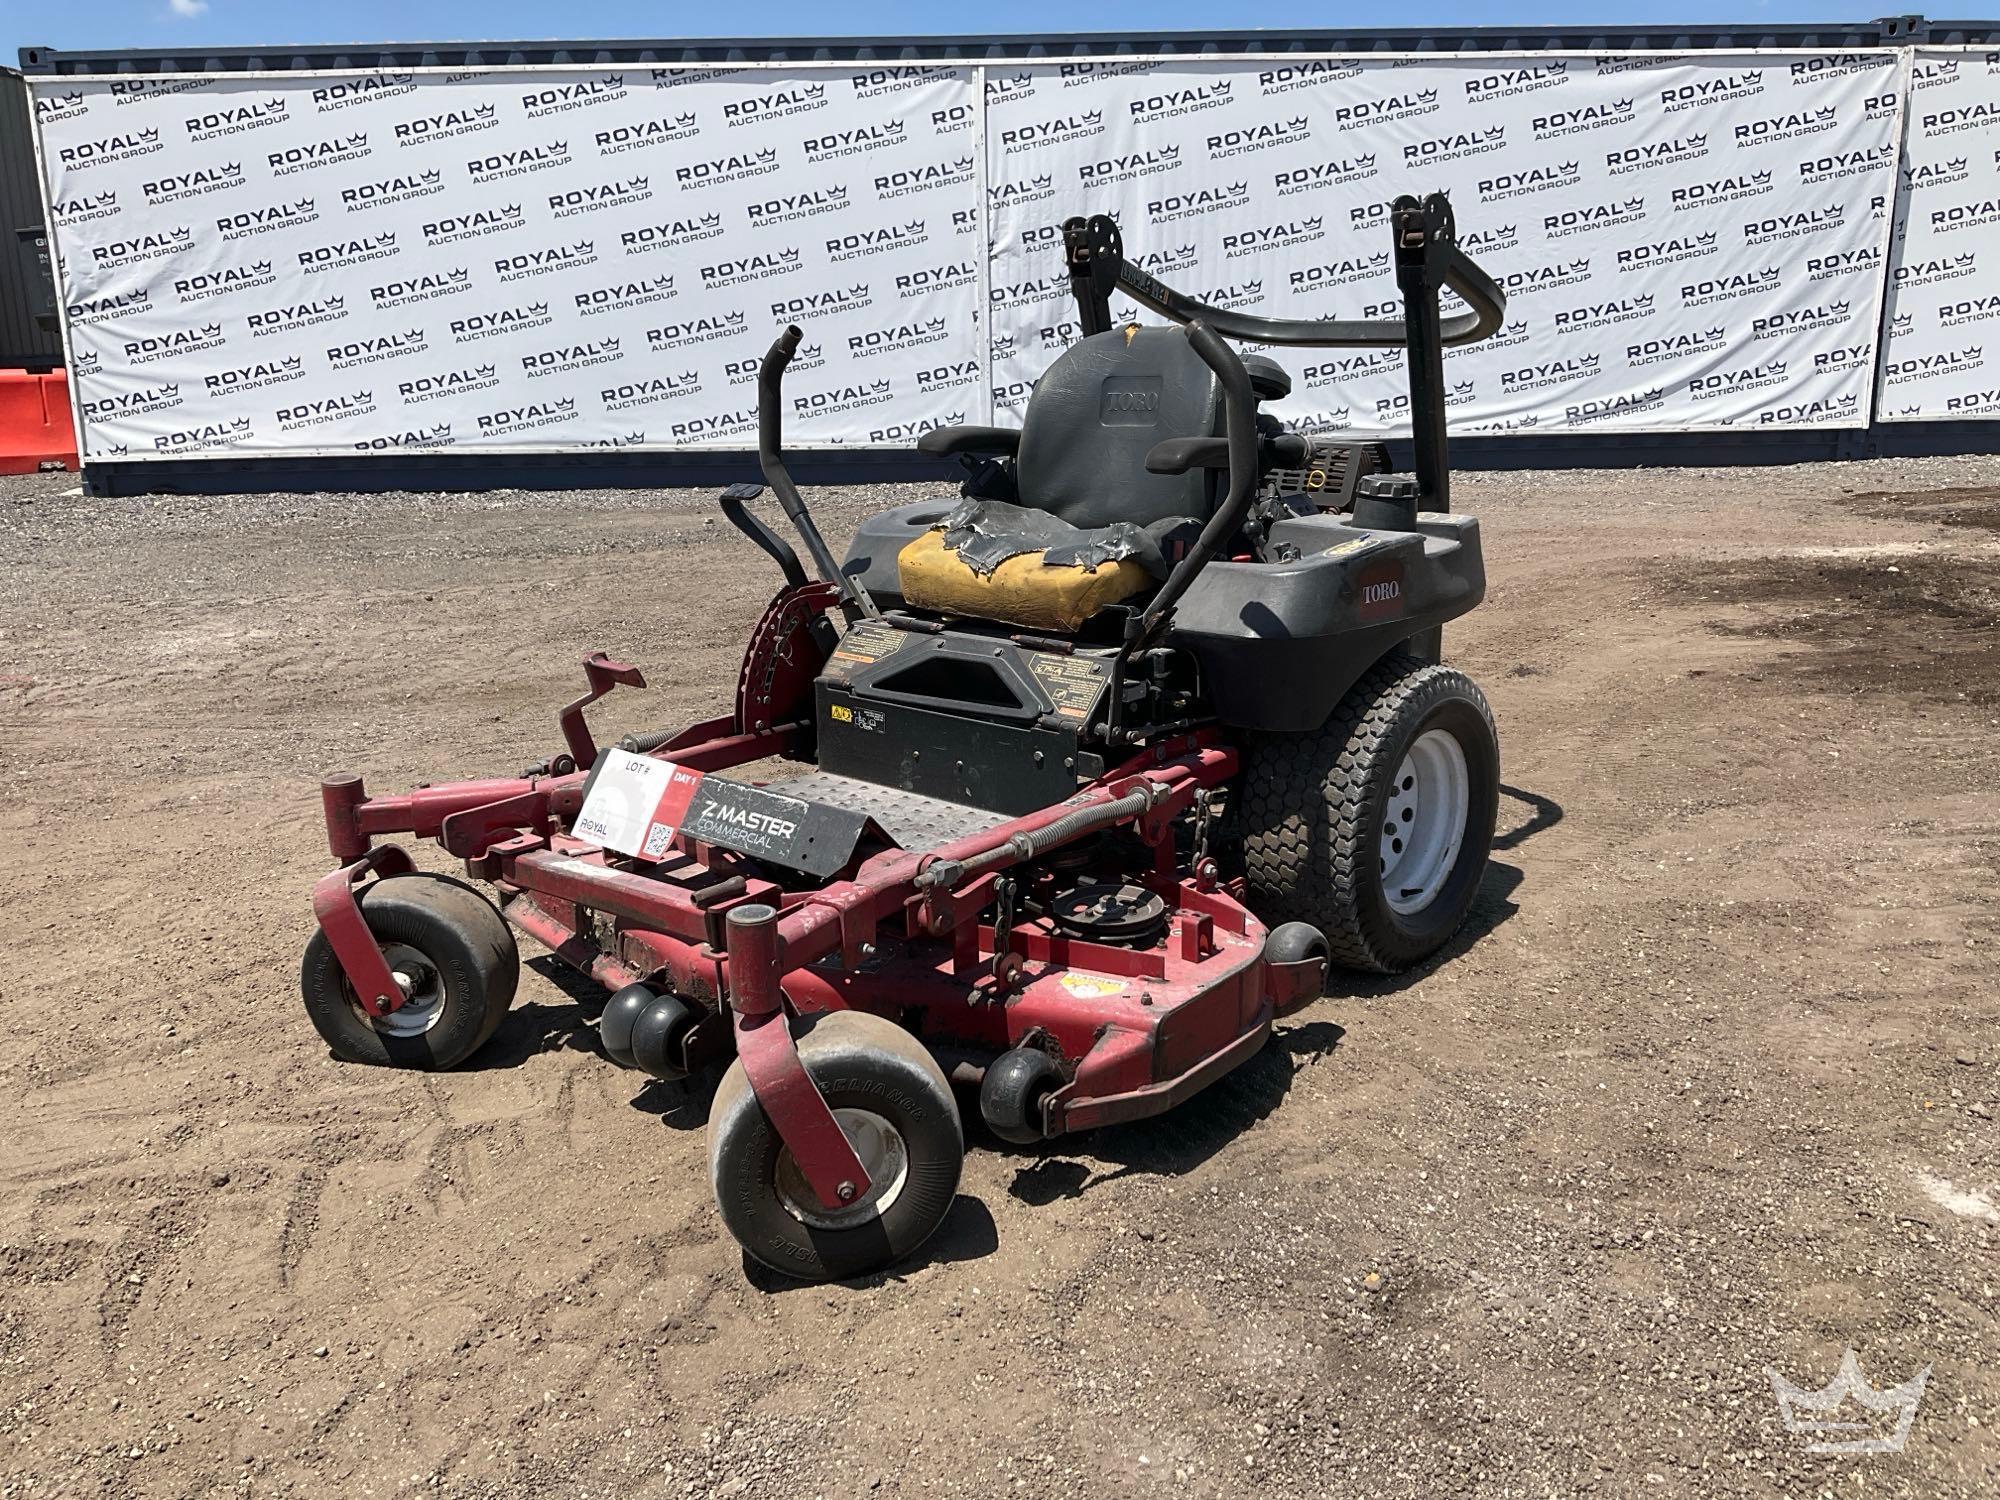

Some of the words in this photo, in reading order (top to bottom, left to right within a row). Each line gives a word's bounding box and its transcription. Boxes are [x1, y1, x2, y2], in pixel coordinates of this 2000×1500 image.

[723, 90, 805, 118] ROYAL
[1130, 87, 1211, 115] ROYAL
[1661, 77, 1742, 104] ROYAL
[1664, 96, 1718, 114] AUCTION
[1720, 86, 1764, 101] GROUP
[185, 105, 266, 133] ROYAL
[394, 110, 476, 138] ROYAL
[729, 110, 783, 128] AUCTION
[785, 100, 828, 115] GROUP
[1133, 107, 1188, 125] AUCTION
[1190, 96, 1234, 112] GROUP
[1532, 104, 1613, 131] ROYAL
[191, 124, 245, 142] AUCTION
[247, 114, 290, 130] GROUP
[400, 129, 454, 148] AUCTION
[456, 119, 499, 135] GROUP
[595, 119, 677, 146] ROYAL
[1001, 117, 1082, 145] ROYAL
[1535, 123, 1590, 141] AUCTION
[1592, 114, 1635, 129] GROUP
[1735, 112, 1815, 139] ROYAL
[1737, 131, 1792, 149] AUCTION
[1794, 121, 1837, 136] GROUP
[59, 134, 140, 163] ROYAL
[267, 139, 348, 167] ROYAL
[600, 138, 655, 156] AUCTION
[656, 128, 700, 144] GROUP
[803, 126, 884, 154] ROYAL
[808, 145, 862, 164] AUCTION
[864, 135, 907, 151] GROUP
[1006, 136, 1060, 155] AUCTION
[1062, 126, 1105, 141] GROUP
[1403, 132, 1484, 159] ROYAL
[1606, 140, 1687, 166] ROYAL
[66, 153, 120, 172] AUCTION
[121, 143, 164, 159] GROUP
[274, 158, 327, 177] AUCTION
[329, 148, 372, 164] GROUP
[467, 147, 549, 175] ROYAL
[1406, 151, 1461, 169] AUCTION
[1463, 141, 1507, 156] GROUP
[1609, 158, 1663, 176] AUCTION
[1665, 149, 1709, 164] GROUP
[473, 166, 527, 184] AUCTION
[529, 156, 572, 172] GROUP
[1275, 160, 1355, 187] ROYAL
[1278, 179, 1332, 196] AUCTION
[1335, 169, 1378, 184] GROUP
[548, 182, 629, 209] ROYAL
[1147, 188, 1227, 215] ROYAL
[1672, 176, 1751, 203] ROYAL
[1674, 194, 1728, 212] AUCTION
[1730, 185, 1774, 200] GROUP
[216, 204, 296, 232] ROYAL
[554, 201, 608, 219] AUCTION
[610, 191, 653, 207] GROUP
[1151, 207, 1204, 225] AUCTION
[1207, 197, 1250, 212] GROUP
[223, 223, 276, 242] AUCTION
[277, 213, 319, 229] GROUP
[1223, 222, 1303, 250] ROYAL
[1744, 210, 1823, 237] ROYAL
[1746, 229, 1800, 246] AUCTION
[1802, 219, 1845, 235] GROUP
[92, 233, 172, 261] ROYAL
[826, 226, 906, 253] ROYAL
[831, 245, 884, 263] AUCTION
[886, 235, 928, 250] GROUP
[1226, 241, 1280, 259] AUCTION
[1282, 231, 1325, 247] GROUP
[98, 252, 151, 270] AUCTION
[153, 242, 195, 257] GROUP
[700, 254, 780, 281] ROYAL
[174, 267, 253, 294] ROYAL
[705, 272, 759, 290] AUCTION
[760, 263, 803, 278] GROUP
[1289, 258, 1369, 285] ROYAL
[1292, 277, 1346, 294] AUCTION
[1348, 267, 1391, 282] GROUP
[180, 285, 233, 303] AUCTION
[234, 275, 276, 291] GROUP
[370, 274, 449, 301] ROYAL
[376, 292, 429, 310] AUCTION
[430, 283, 472, 298] GROUP
[1681, 273, 1760, 299] ROYAL
[1683, 291, 1737, 308] AUCTION
[1739, 281, 1781, 296] GROUP
[771, 290, 850, 316] ROYAL
[776, 308, 828, 325] AUCTION
[830, 299, 872, 314] GROUP
[1555, 300, 1634, 326] ROYAL
[450, 308, 529, 334] ROYAL
[456, 326, 508, 343] AUCTION
[510, 317, 552, 332] GROUP
[646, 317, 725, 343] ROYAL
[1557, 317, 1611, 335] AUCTION
[1613, 308, 1656, 323] GROUP
[1752, 306, 1830, 333] ROYAL
[1753, 324, 1807, 341] AUCTION
[1809, 315, 1851, 329] GROUP
[124, 330, 203, 357] ROYAL
[130, 348, 183, 365] AUCTION
[184, 338, 226, 353] GROUP
[327, 335, 405, 361] ROYAL
[652, 335, 704, 352] AUCTION
[706, 326, 748, 340] GROUP
[1627, 333, 1705, 359] ROYAL
[332, 353, 385, 370] AUCTION
[386, 344, 428, 358] GROUP
[1629, 350, 1682, 367] AUCTION
[1684, 341, 1727, 356] GROUP
[1884, 352, 1962, 377] ROYAL
[204, 362, 283, 389] ROYAL
[210, 380, 262, 398] AUCTION
[264, 371, 306, 385] GROUP
[398, 370, 477, 396] ROYAL
[1501, 359, 1580, 385] ROYAL
[1504, 377, 1557, 394] AUCTION
[1559, 368, 1601, 383] GROUP
[1887, 369, 1939, 386] AUCTION
[1942, 360, 1984, 374] GROUP
[404, 388, 456, 405] AUCTION
[458, 379, 500, 393] GROUP
[601, 377, 680, 403] ROYAL
[606, 395, 659, 411] AUCTION
[660, 386, 702, 400] GROUP
[794, 385, 871, 411] ROYAL
[1105, 391, 1158, 411] TORO
[276, 397, 354, 422] ROYAL
[282, 415, 333, 431] AUCTION
[335, 405, 376, 420] GROUP
[477, 403, 556, 429] ROYAL
[799, 403, 850, 420] AUCTION
[852, 394, 893, 408] GROUP
[483, 421, 535, 438] AUCTION
[537, 412, 579, 426] GROUP
[1362, 581, 1400, 604] TORO
[625, 760, 644, 774] LOT
[673, 772, 691, 785] DAY
[690, 777, 697, 786] 1
[580, 818, 607, 836] ROYAL
[698, 817, 771, 848] COMMERCIAL
[701, 800, 717, 817] Z
[719, 804, 797, 839] MASTER
